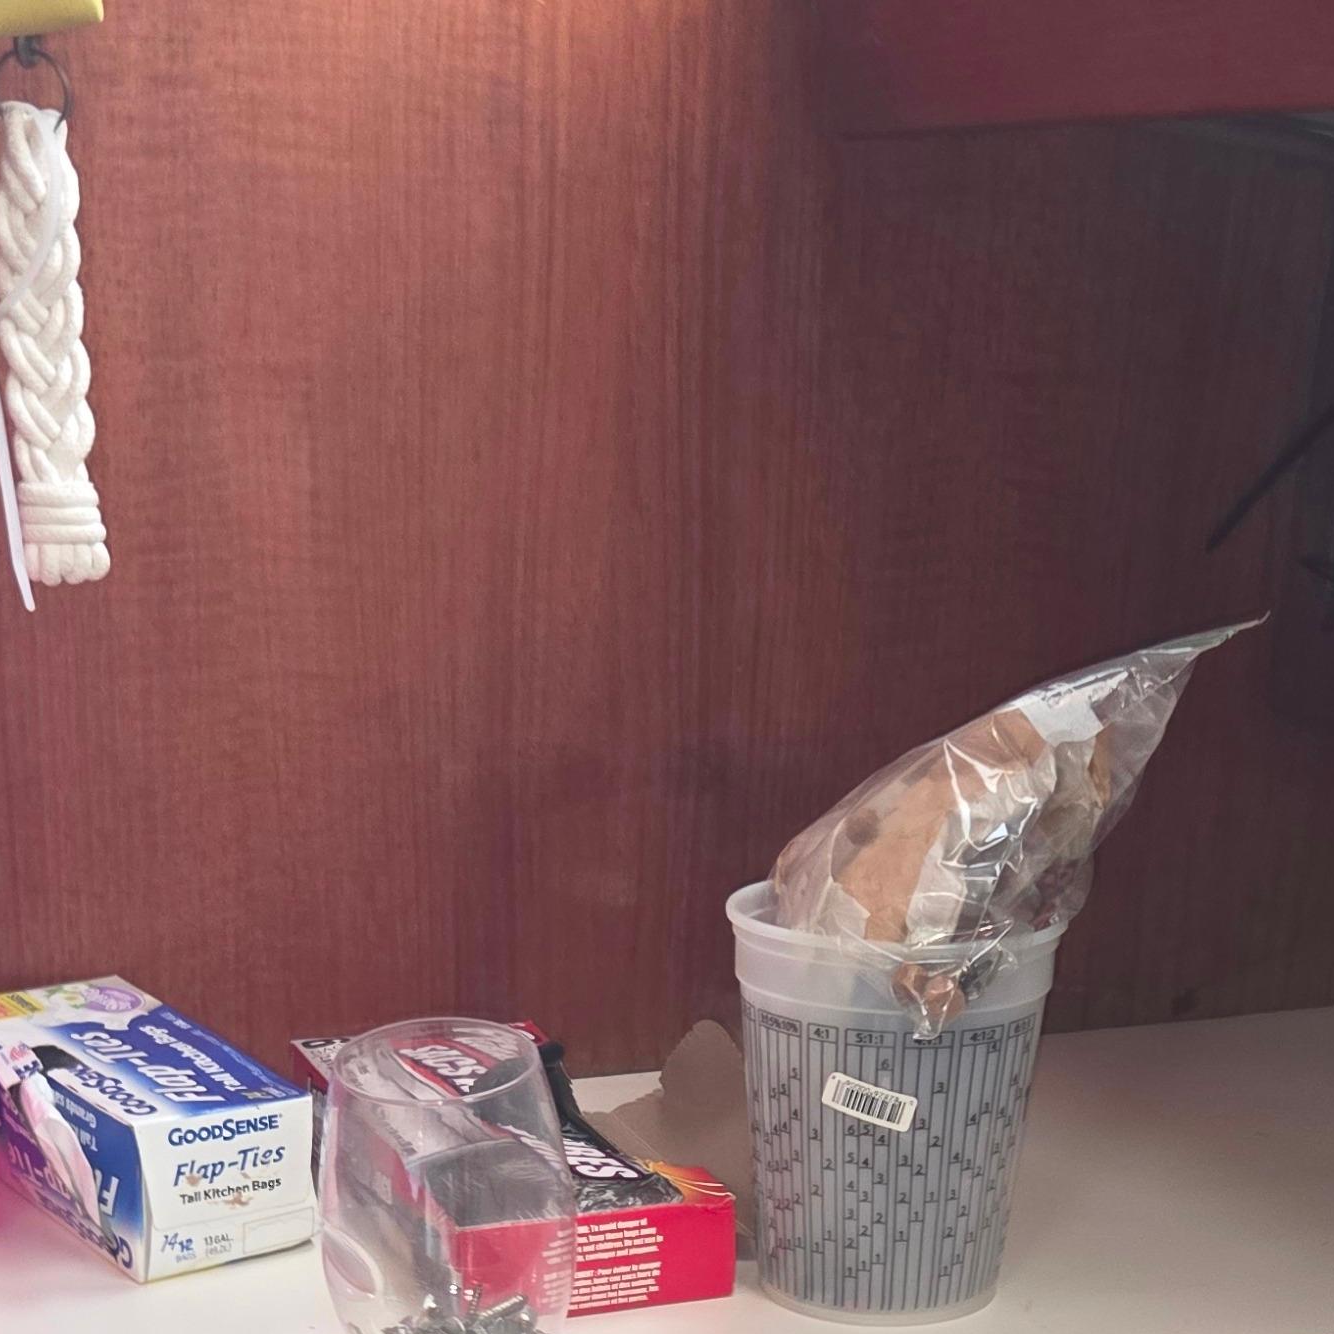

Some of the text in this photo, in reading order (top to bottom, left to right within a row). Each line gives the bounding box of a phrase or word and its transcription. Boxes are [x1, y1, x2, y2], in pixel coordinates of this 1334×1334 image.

[813, 1027, 830, 1040] 4:1
[855, 1032, 885, 1044] 5:1:1
[969, 1029, 997, 1042] 4:1:2
[70, 1031, 228, 1103] Flap-Ties
[213, 1072, 247, 1092] Tall
[168, 1114, 280, 1147] GOODSENSE
[173, 1146, 286, 1187] Flap-Ties
[179, 1177, 282, 1206] Tall Kitchen Bags
